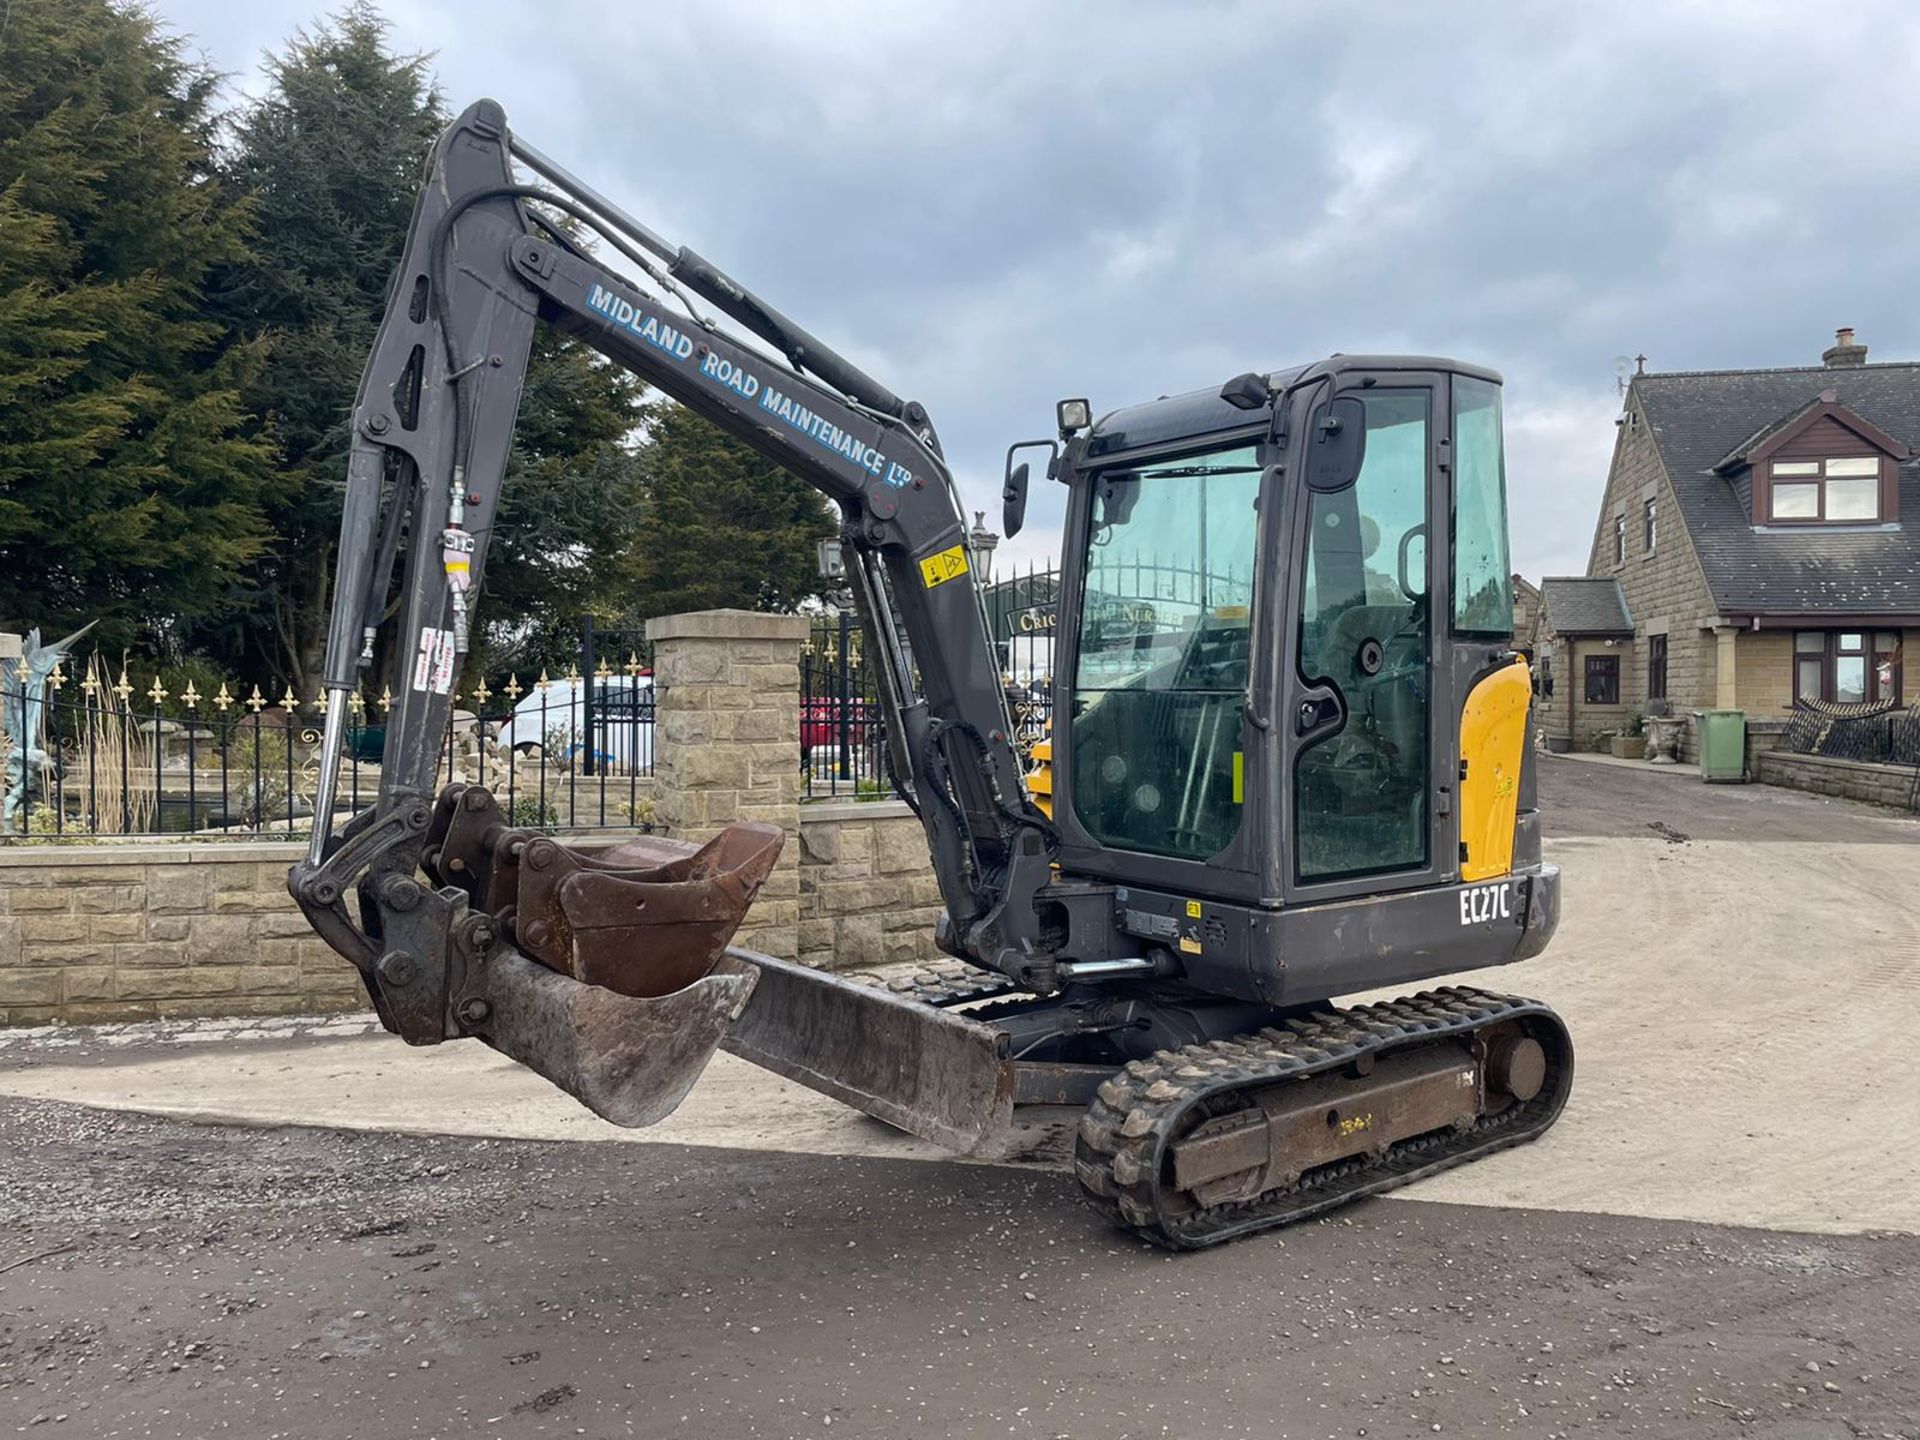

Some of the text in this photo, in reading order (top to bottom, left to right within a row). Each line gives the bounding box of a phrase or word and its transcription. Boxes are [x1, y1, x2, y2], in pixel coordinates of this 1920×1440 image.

[588, 283, 694, 360] MIDLAND
[701, 351, 760, 398] ROAD
[760, 385, 887, 475] MAINTENANCE
[1459, 883, 1510, 926] EC27C
